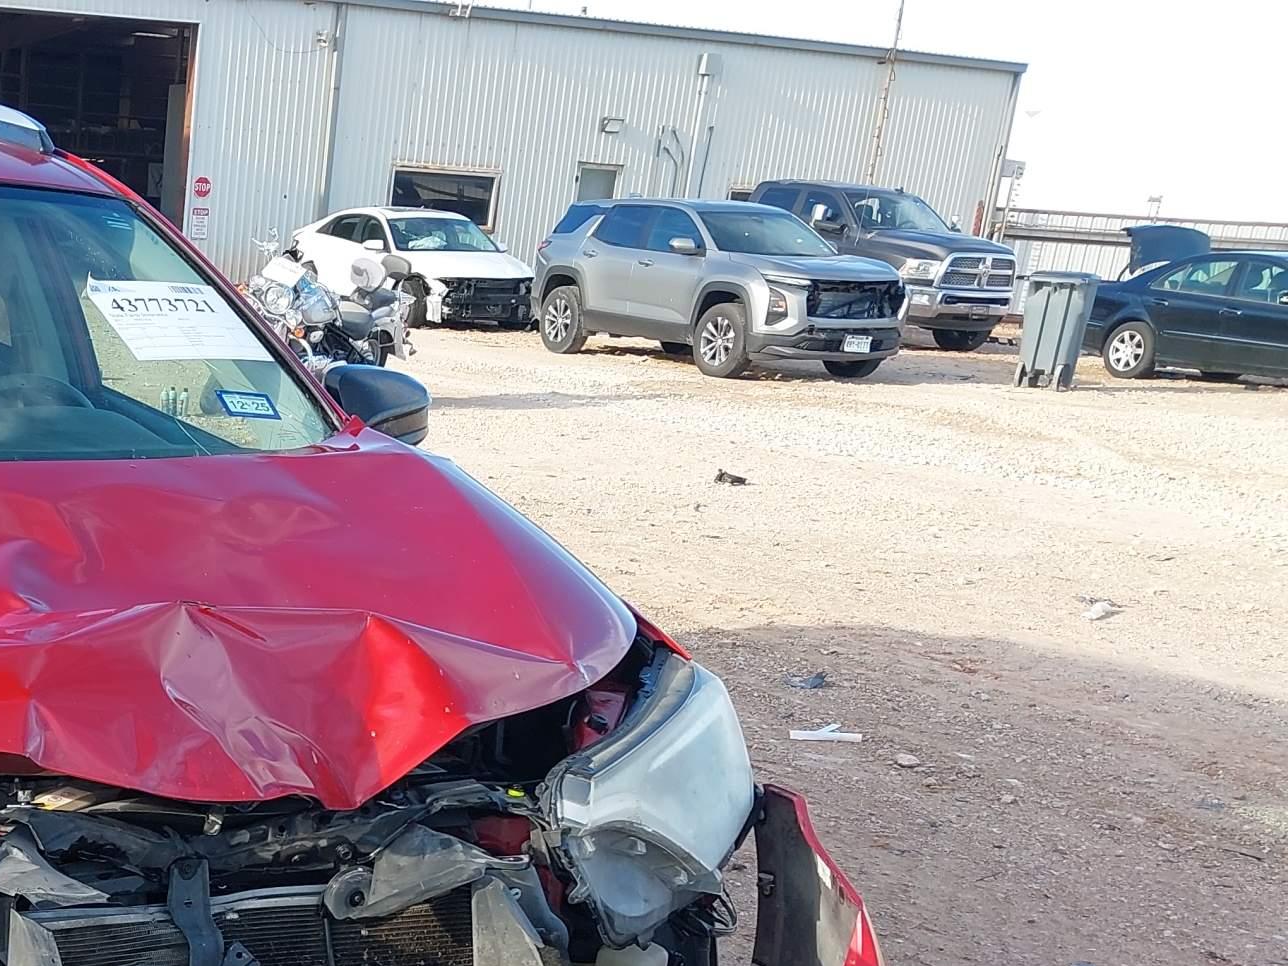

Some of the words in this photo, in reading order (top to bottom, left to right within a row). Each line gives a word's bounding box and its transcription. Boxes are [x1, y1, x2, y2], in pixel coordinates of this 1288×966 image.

[194, 182, 210, 192] STOP
[111, 298, 216, 313] 43773721
[229, 400, 248, 409] 12
[252, 401, 269, 411] 25
